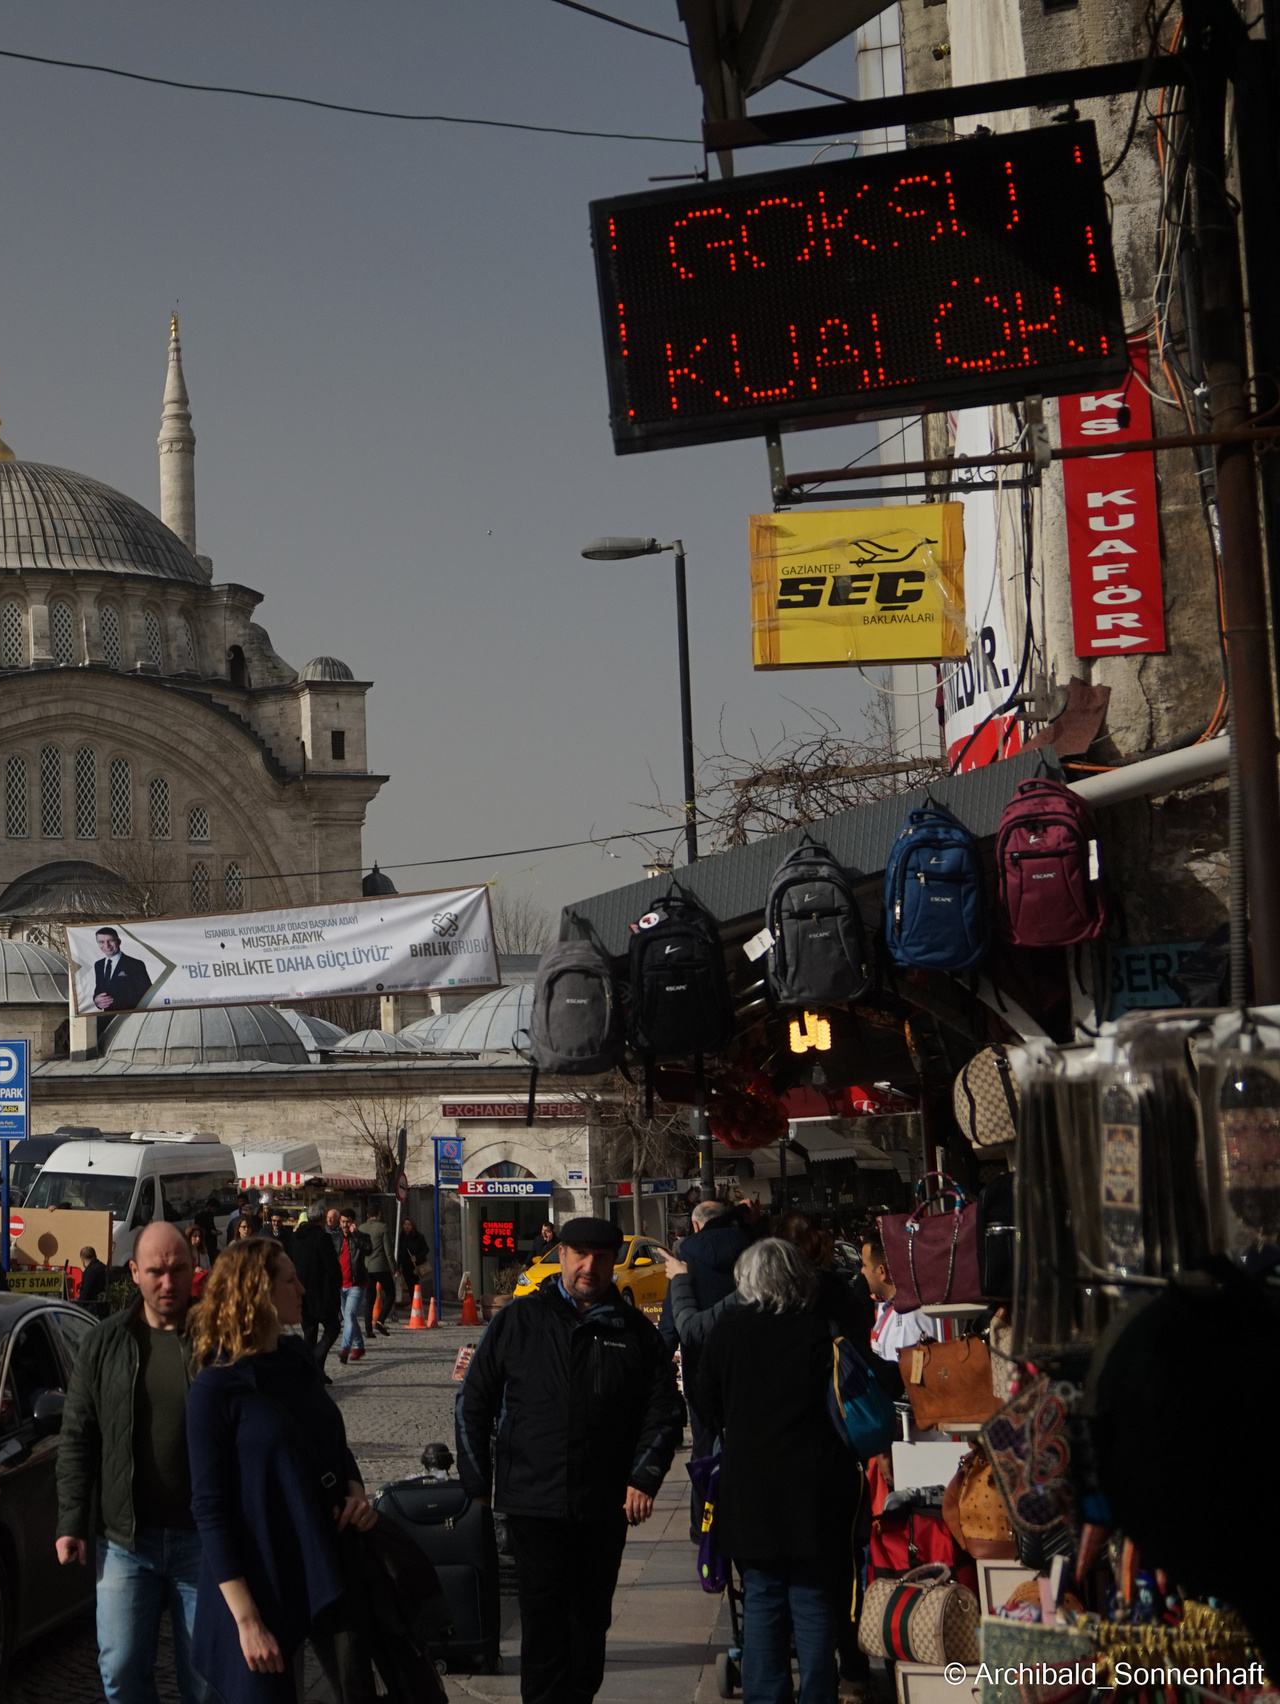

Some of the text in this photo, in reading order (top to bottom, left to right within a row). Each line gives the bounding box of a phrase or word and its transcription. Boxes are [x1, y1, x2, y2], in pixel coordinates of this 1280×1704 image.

[1086, 488, 1144, 630] KUAFÖR
[781, 563, 841, 576] GAZİANTEP
[777, 570, 926, 612] SEÇ
[862, 612, 935, 626] BAKLAVALARI
[204, 915, 359, 939] İSTANBUL KUYUMCULAR ODASI BAŞKAN ADAYI
[241, 933, 290, 949] MUSTAFA
[291, 930, 326, 945] ATAYIK
[212, 958, 275, 978] BİRLİKTE
[276, 955, 315, 973] DAHA
[445, 1104, 526, 1116] EXCHANGE
[466, 1181, 534, 1195] Ex change
[482, 1221, 514, 1230] CHANGE
[484, 1228, 512, 1236] OFFICE
[28, 1277, 60, 1288] STAMP
